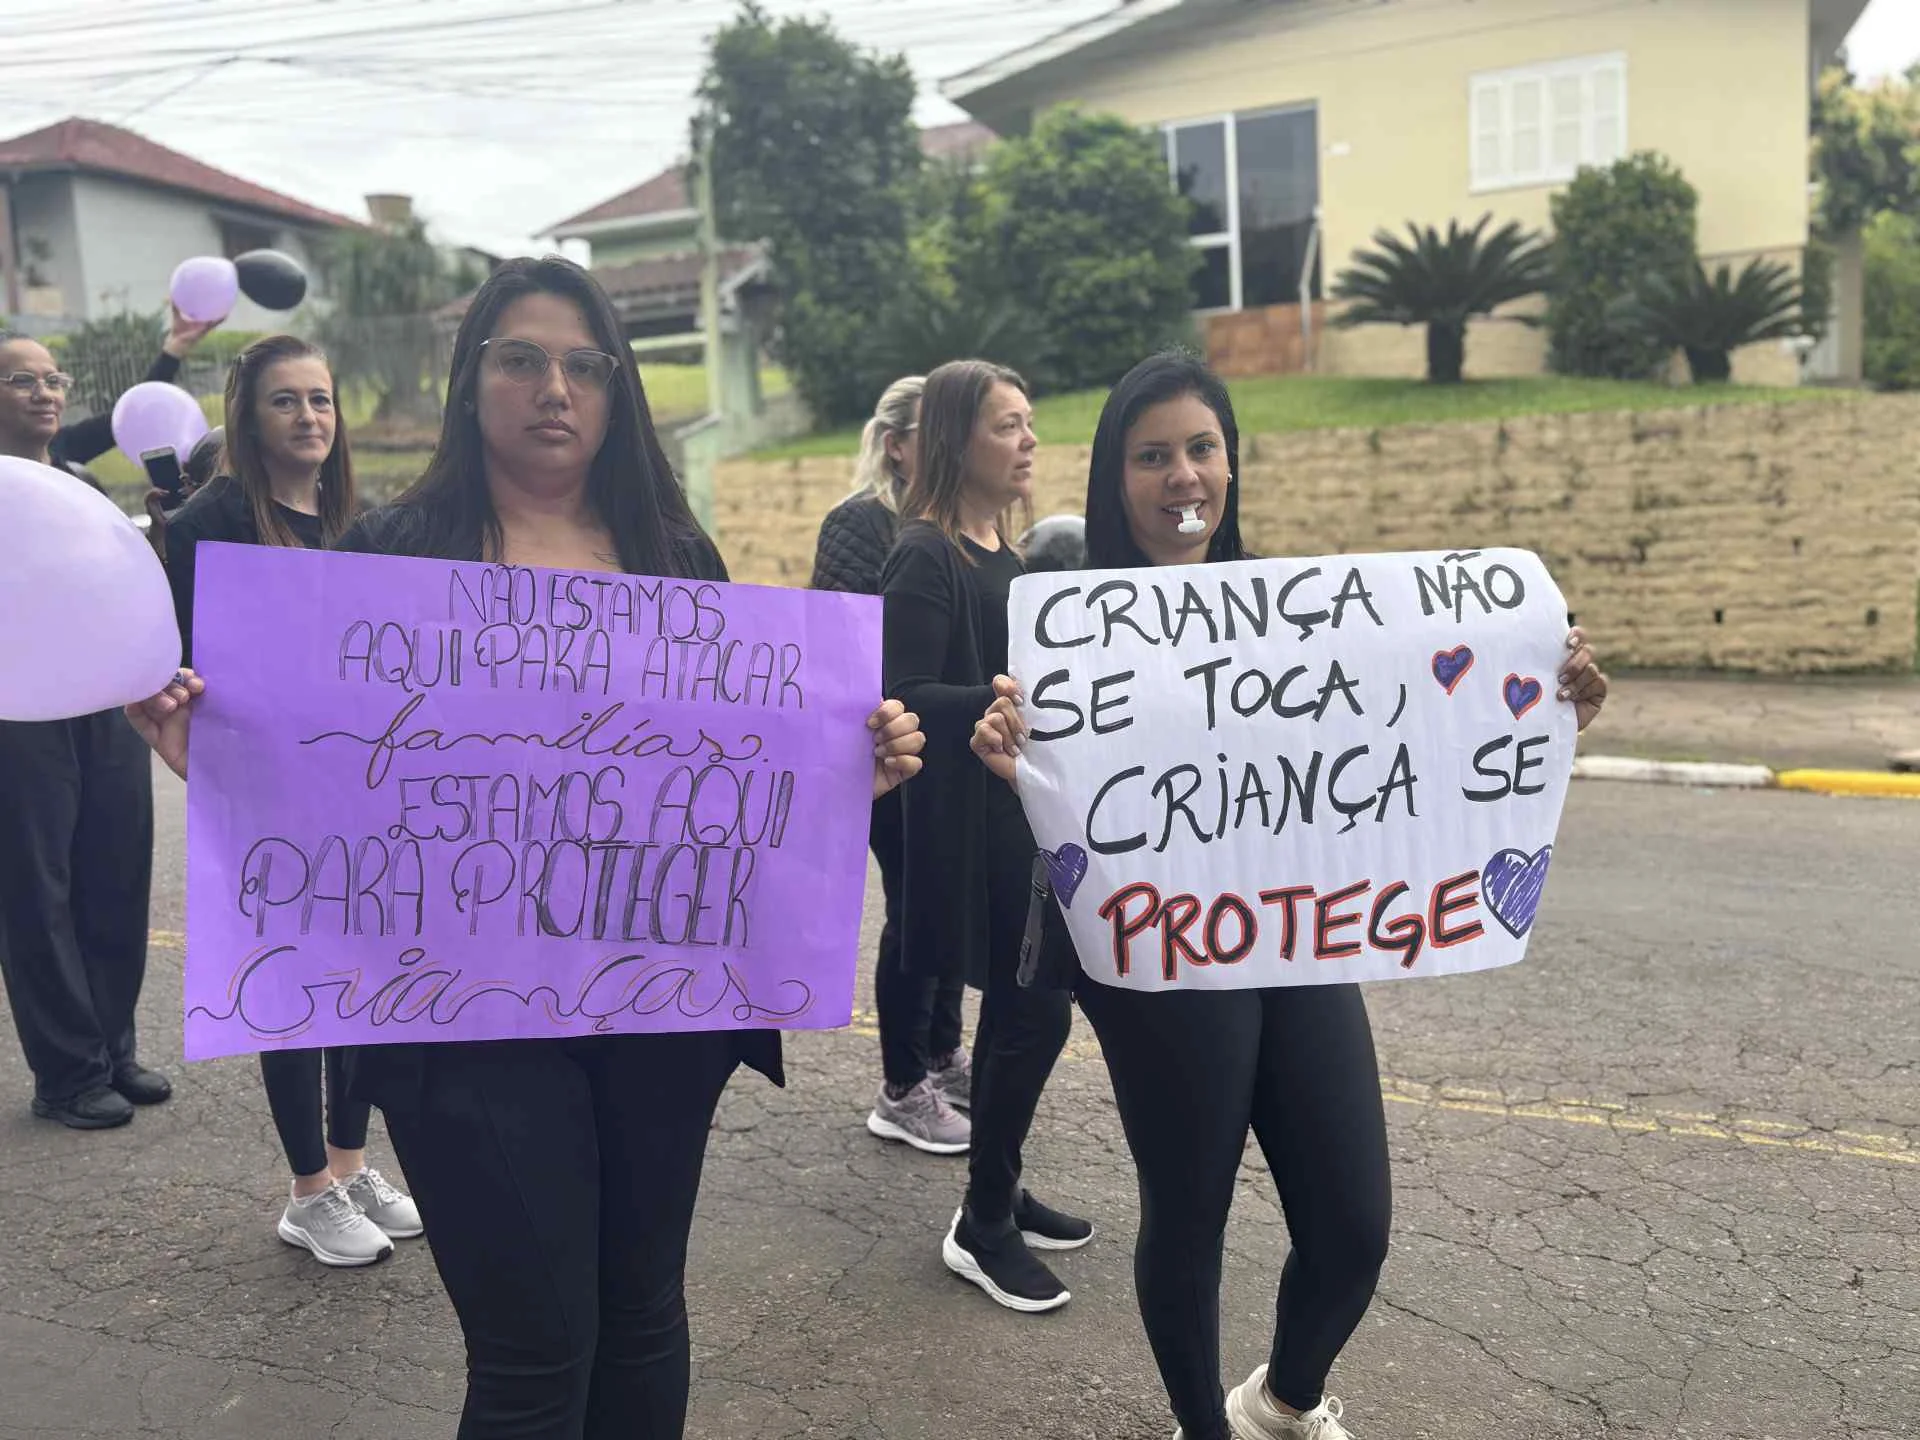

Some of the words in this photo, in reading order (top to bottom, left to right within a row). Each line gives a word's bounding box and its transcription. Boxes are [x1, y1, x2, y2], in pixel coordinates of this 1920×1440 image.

[449, 563, 536, 626] NÃO
[546, 574, 726, 641] ESTAMOS
[1034, 566, 1384, 648] CRIANÇA
[1414, 551, 1525, 624] NÃO
[339, 619, 462, 694] AQUI
[474, 622, 611, 696] PARA
[641, 636, 803, 709] ATACAR
[1028, 669, 1135, 742] SE
[387, 765, 626, 842] ESTAMOS
[648, 765, 794, 848] AQUI
[1461, 734, 1550, 803] SE
[238, 834, 424, 937] PARA
[451, 838, 758, 948] PROTEGER
[1097, 870, 1485, 981] PROTEGE
